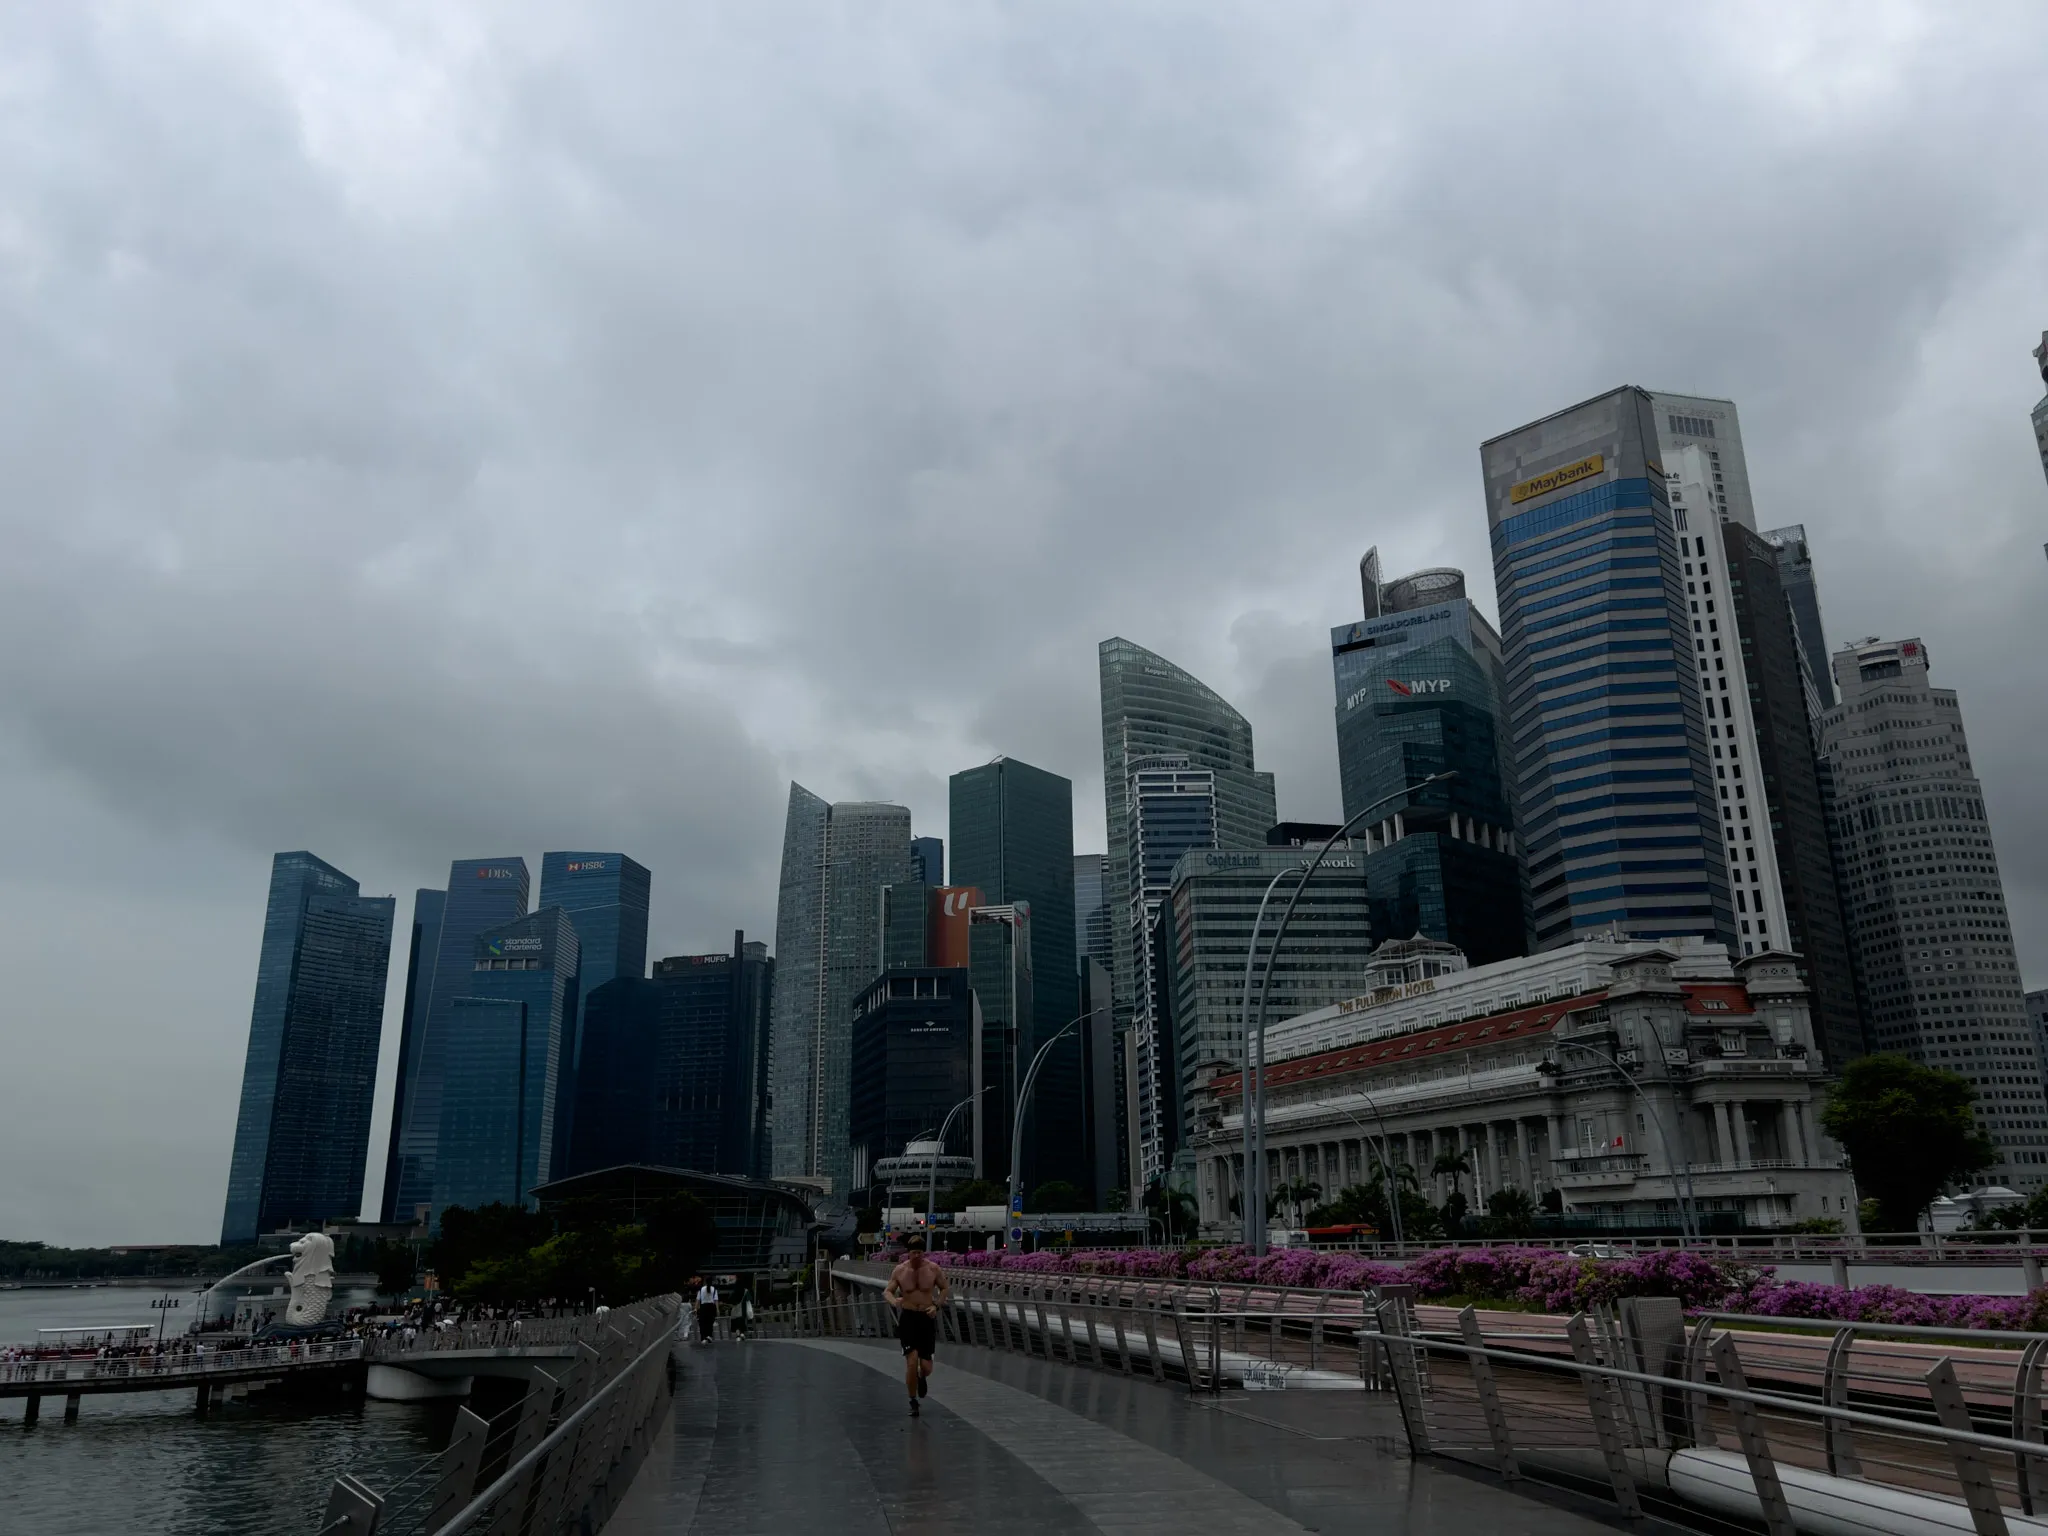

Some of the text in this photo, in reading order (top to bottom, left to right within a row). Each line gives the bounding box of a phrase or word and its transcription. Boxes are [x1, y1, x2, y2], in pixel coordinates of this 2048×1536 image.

[1529, 460, 1594, 494] Maybank
[1367, 610, 1451, 636] SINGAPORELAND
[1900, 656, 1924, 668] UOB
[1411, 679, 1451, 694] MYP
[1346, 687, 1367, 711] MYP
[581, 860, 606, 870] HSBC
[1206, 853, 1260, 868] CapitaLand
[1300, 855, 1356, 869] wwork
[488, 868, 513, 879] DBS
[504, 937, 541, 945] standard
[504, 943, 543, 951] chartered
[703, 955, 726, 964] MUFG
[1339, 979, 1436, 1014] THE FULLERTON HOTEL
